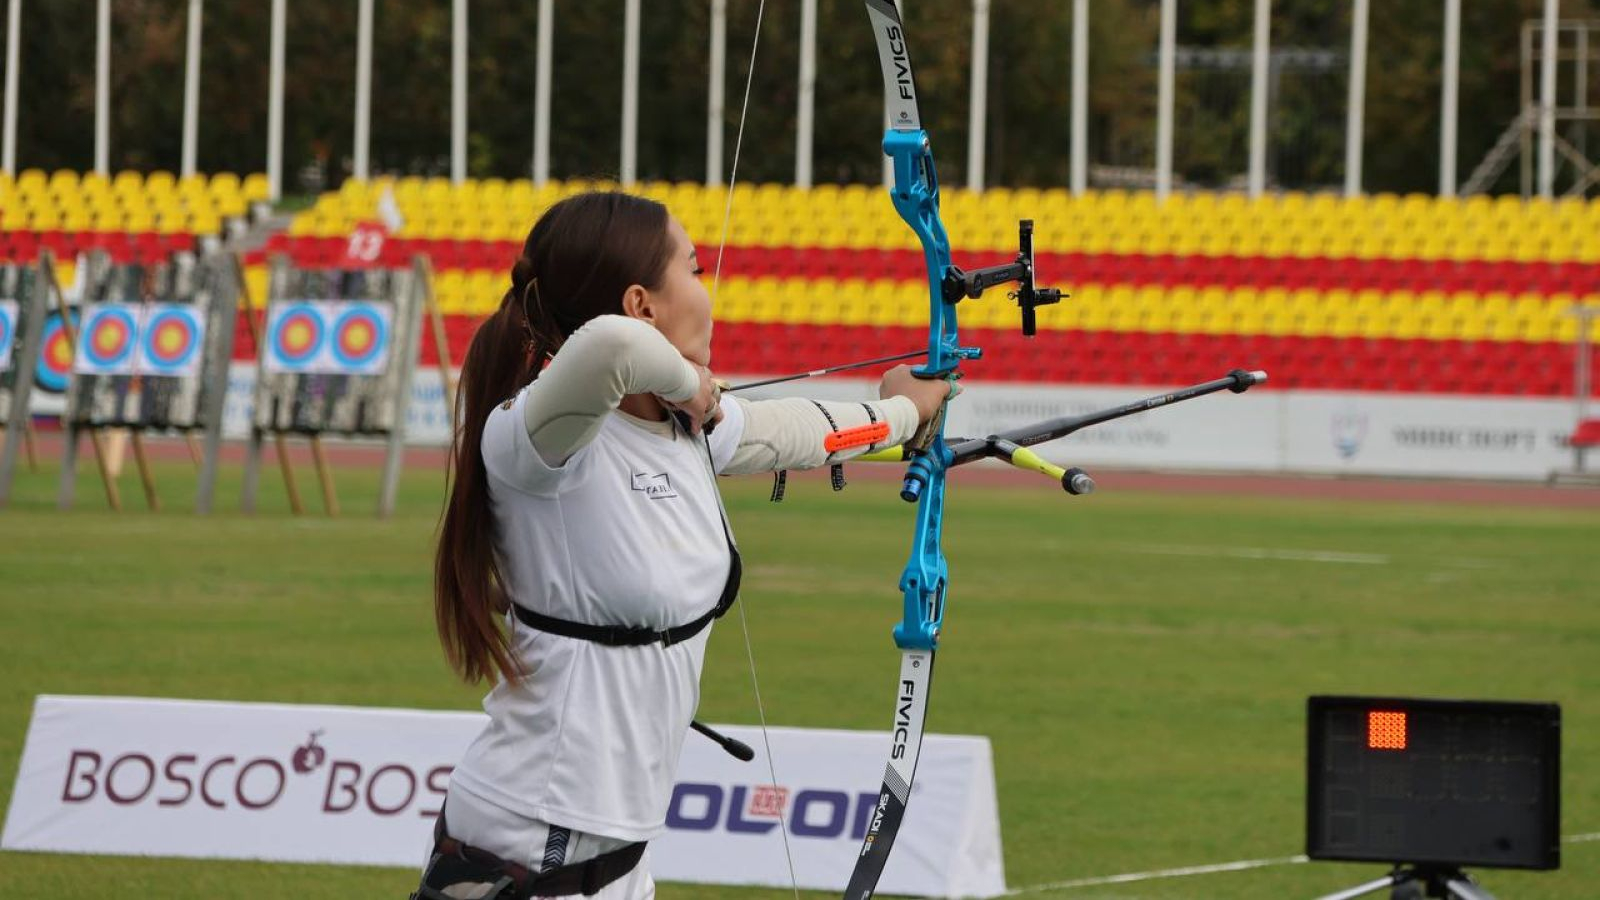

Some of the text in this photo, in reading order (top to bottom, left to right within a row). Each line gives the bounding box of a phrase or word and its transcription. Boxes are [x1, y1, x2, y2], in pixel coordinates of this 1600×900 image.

[886, 25, 914, 100] FIVICS
[891, 679, 915, 761] FIVICS
[62, 750, 286, 810] BOSCO
[871, 793, 889, 832] SKADI
